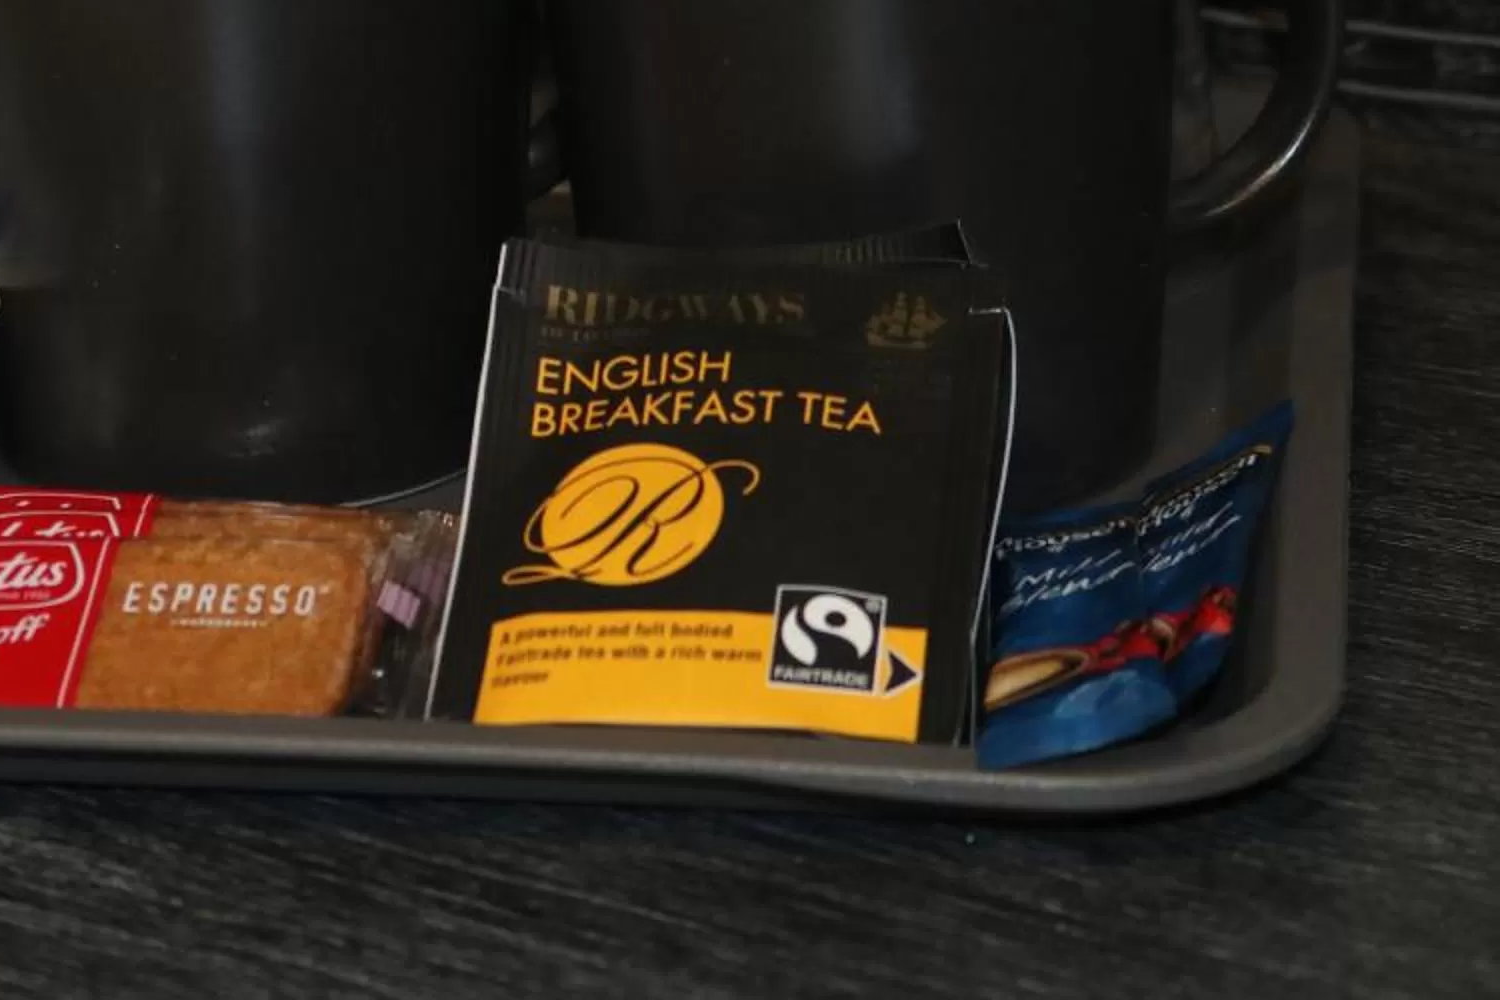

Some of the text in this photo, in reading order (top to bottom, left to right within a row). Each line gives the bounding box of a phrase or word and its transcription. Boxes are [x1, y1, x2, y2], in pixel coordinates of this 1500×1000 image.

[544, 283, 806, 327] RIDGWAYS
[535, 350, 733, 396] ENGLISH
[530, 390, 882, 437] BREAKFAST TEA
[121, 581, 317, 617] ESPRESSO
[500, 622, 734, 645] A powerful and full bodied
[495, 644, 762, 667] Fairtrade tea with a rich warm
[773, 664, 870, 688] FAIRTRADE
